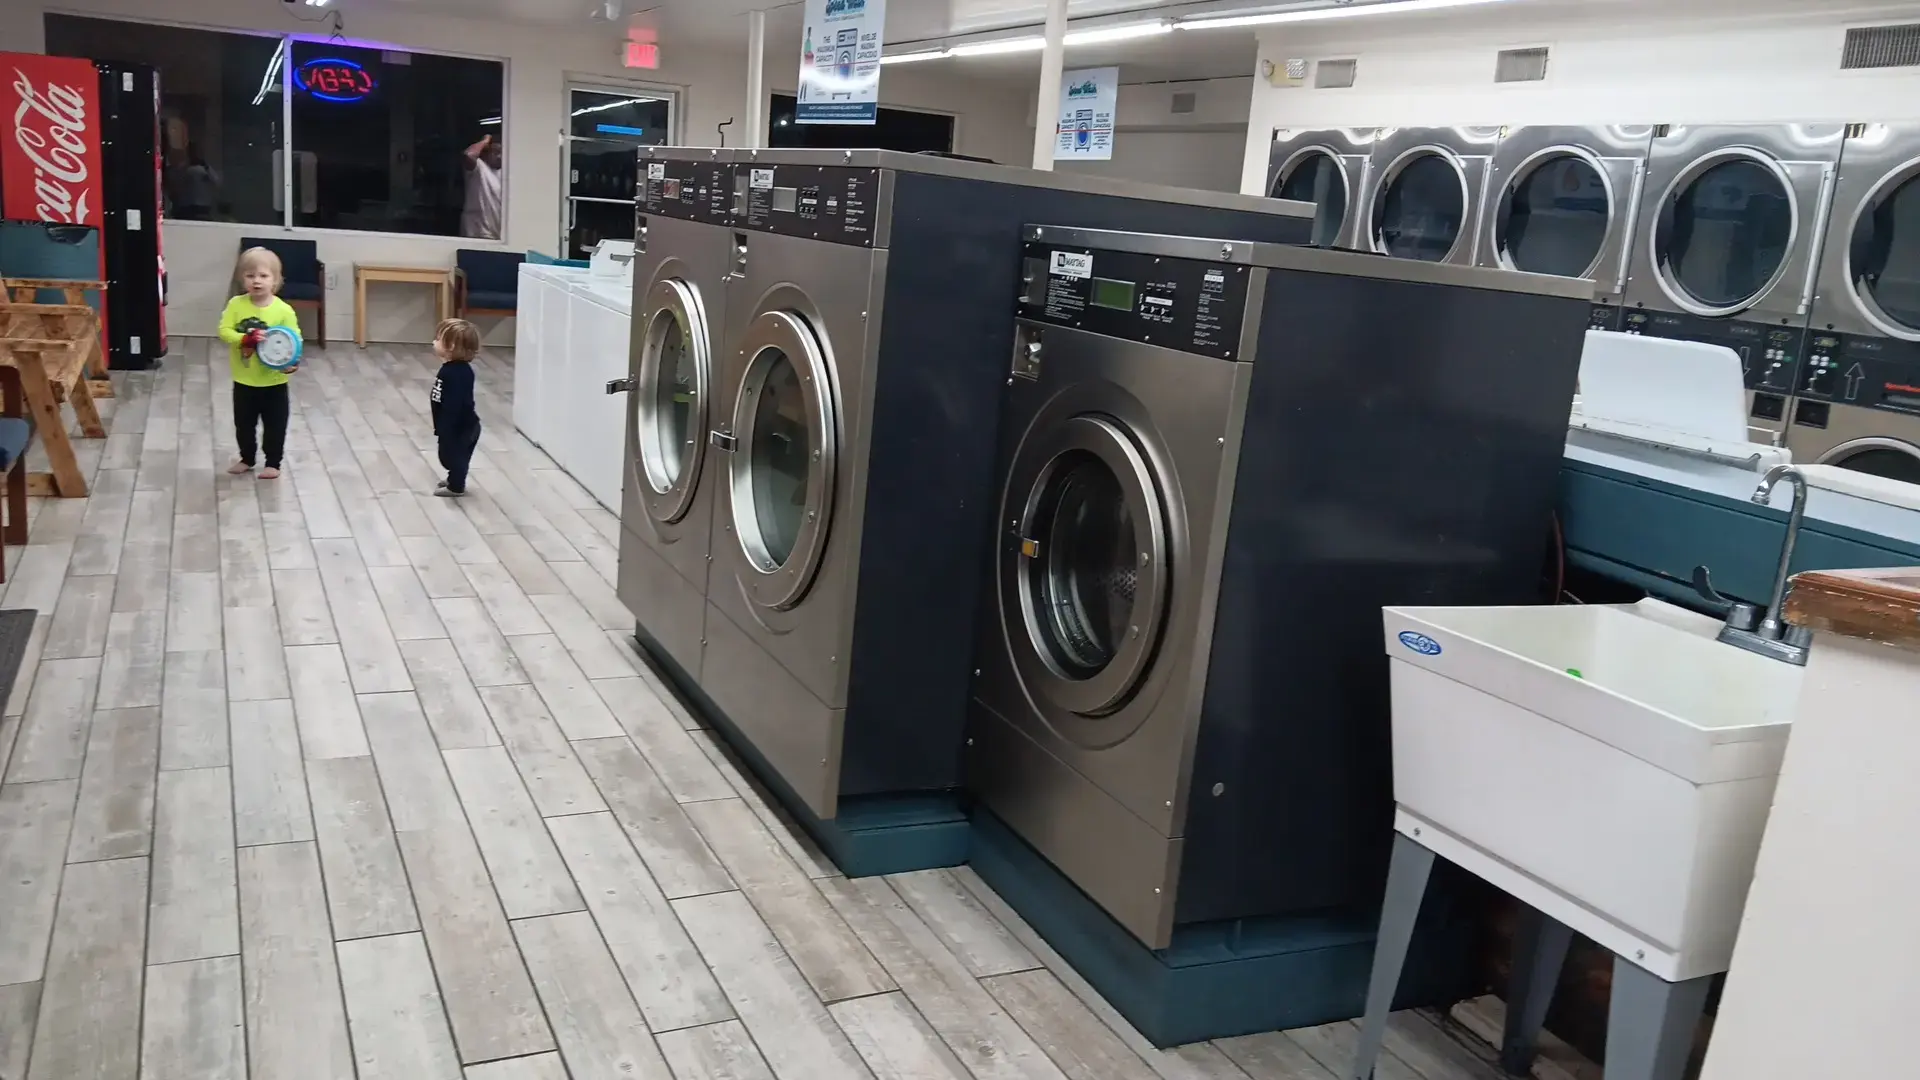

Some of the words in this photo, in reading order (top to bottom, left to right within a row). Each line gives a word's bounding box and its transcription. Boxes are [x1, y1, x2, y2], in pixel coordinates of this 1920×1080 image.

[628, 45, 656, 66] EXIT
[1848, 124, 1864, 138] 11
[12, 66, 88, 223] ca-Cola
